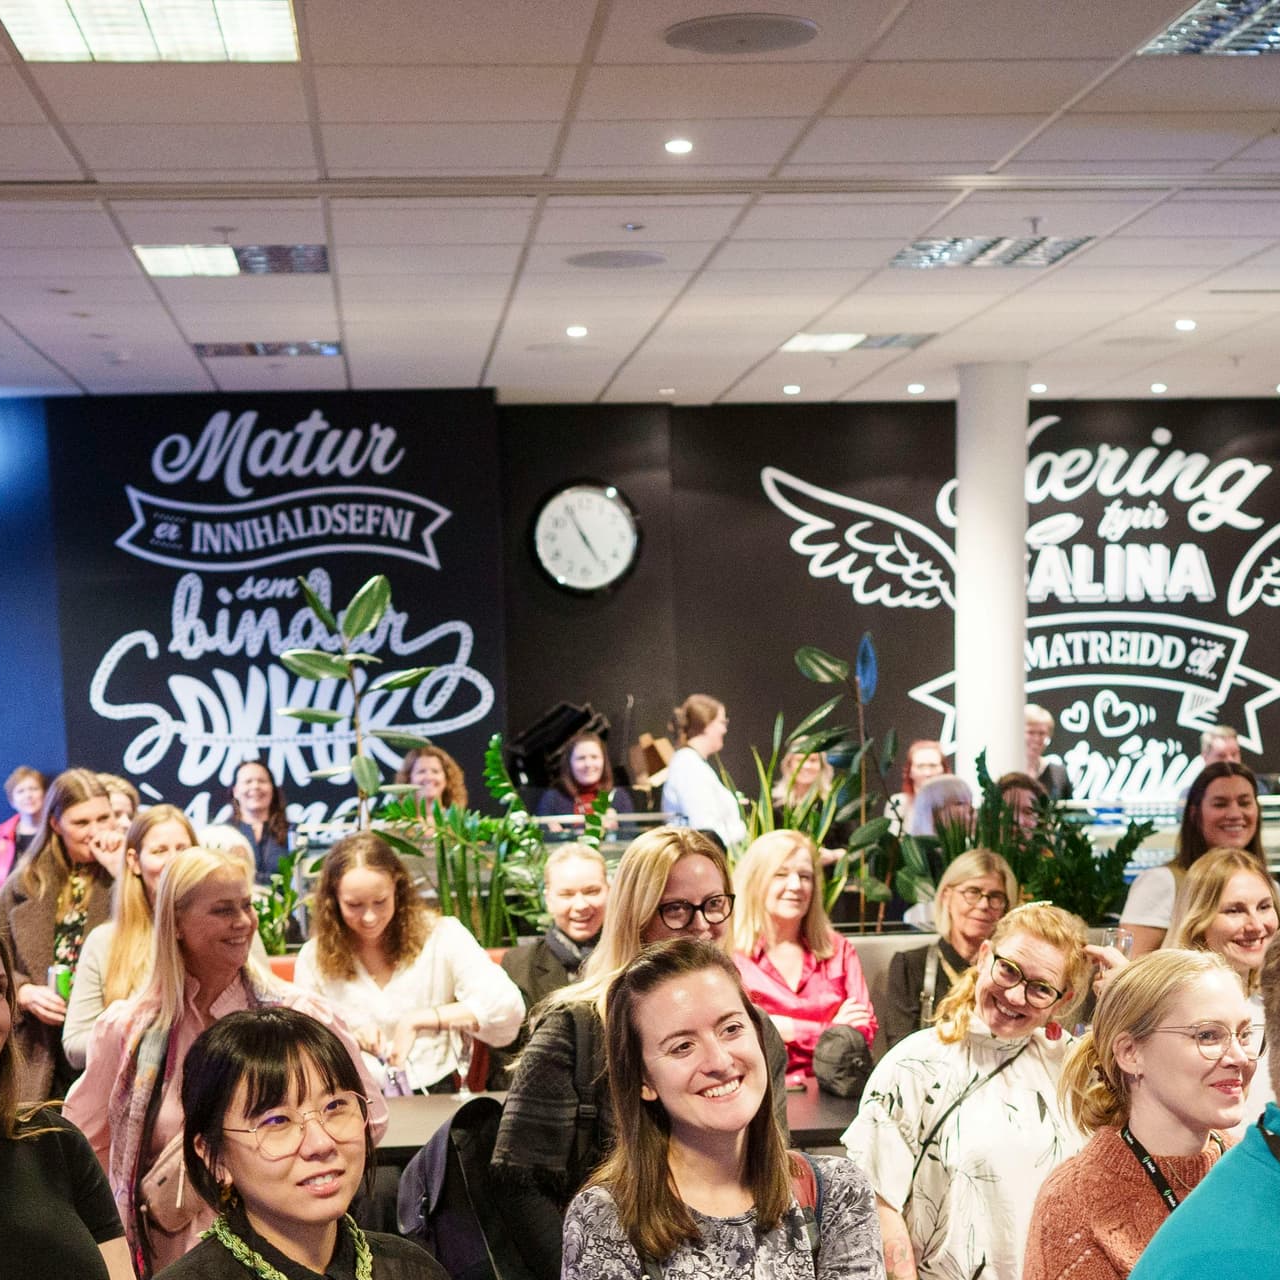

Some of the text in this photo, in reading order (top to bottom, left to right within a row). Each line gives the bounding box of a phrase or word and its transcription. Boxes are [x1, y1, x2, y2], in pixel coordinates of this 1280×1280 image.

[151, 409, 406, 498] Matur
[936, 415, 1273, 532] æring
[191, 502, 415, 553] INNIHALDSEFNI
[235, 575, 300, 600] sem
